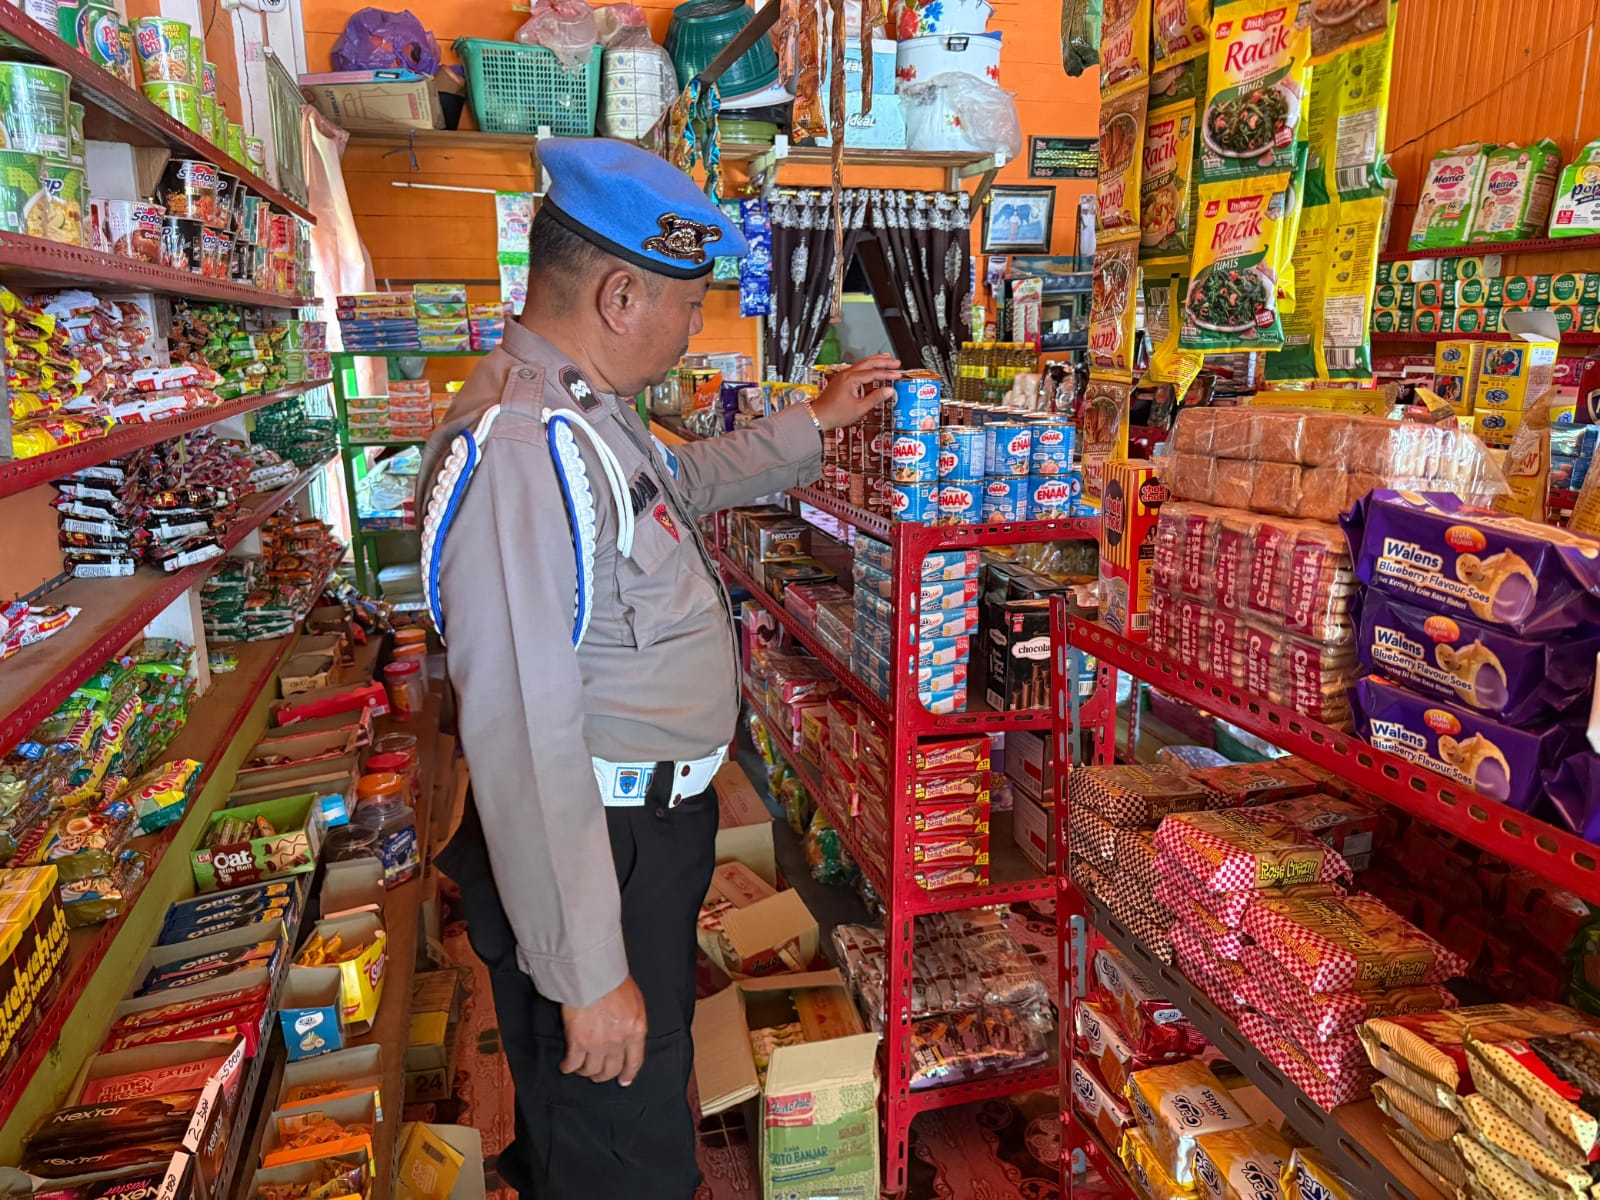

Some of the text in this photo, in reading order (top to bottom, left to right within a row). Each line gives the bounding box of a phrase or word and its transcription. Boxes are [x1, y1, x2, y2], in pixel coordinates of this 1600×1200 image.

[1223, 25, 1290, 73] Racik
[1141, 134, 1178, 171] Racik
[1432, 173, 1466, 185] Merries
[1488, 180, 1520, 192] Merries
[1210, 210, 1264, 251] Racik
[1464, 285, 1481, 293] PASEO
[1507, 282, 1526, 290] PASEO
[1555, 282, 1574, 290] PASEO
[1460, 314, 1477, 322] PASEO
[1036, 485, 1068, 500] ENAAK
[1386, 541, 1440, 569] Walens
[1223, 539, 1238, 609] Cantik
[1256, 534, 1281, 607] Cantik
[1294, 549, 1321, 627] Cantik
[1378, 560, 1491, 604] Blueberry Flavour Soes
[1377, 629, 1422, 656] Walens
[1373, 647, 1473, 691] Blueberry Flavour Soes
[1373, 721, 1425, 748] Walens
[1372, 739, 1473, 785] Blueberry Flavour Soes
[213, 850, 253, 869] Oat
[1260, 857, 1318, 880] Rose Cream
[195, 894, 242, 911] OREO
[196, 906, 243, 924] OREO
[187, 920, 236, 939] OREO
[179, 951, 229, 970] OREO
[1361, 961, 1390, 981] Rose
[167, 968, 219, 988] OREO
[1173, 1093, 1203, 1128] Gery
[769, 1145, 829, 1166] SOTO BANJAR
